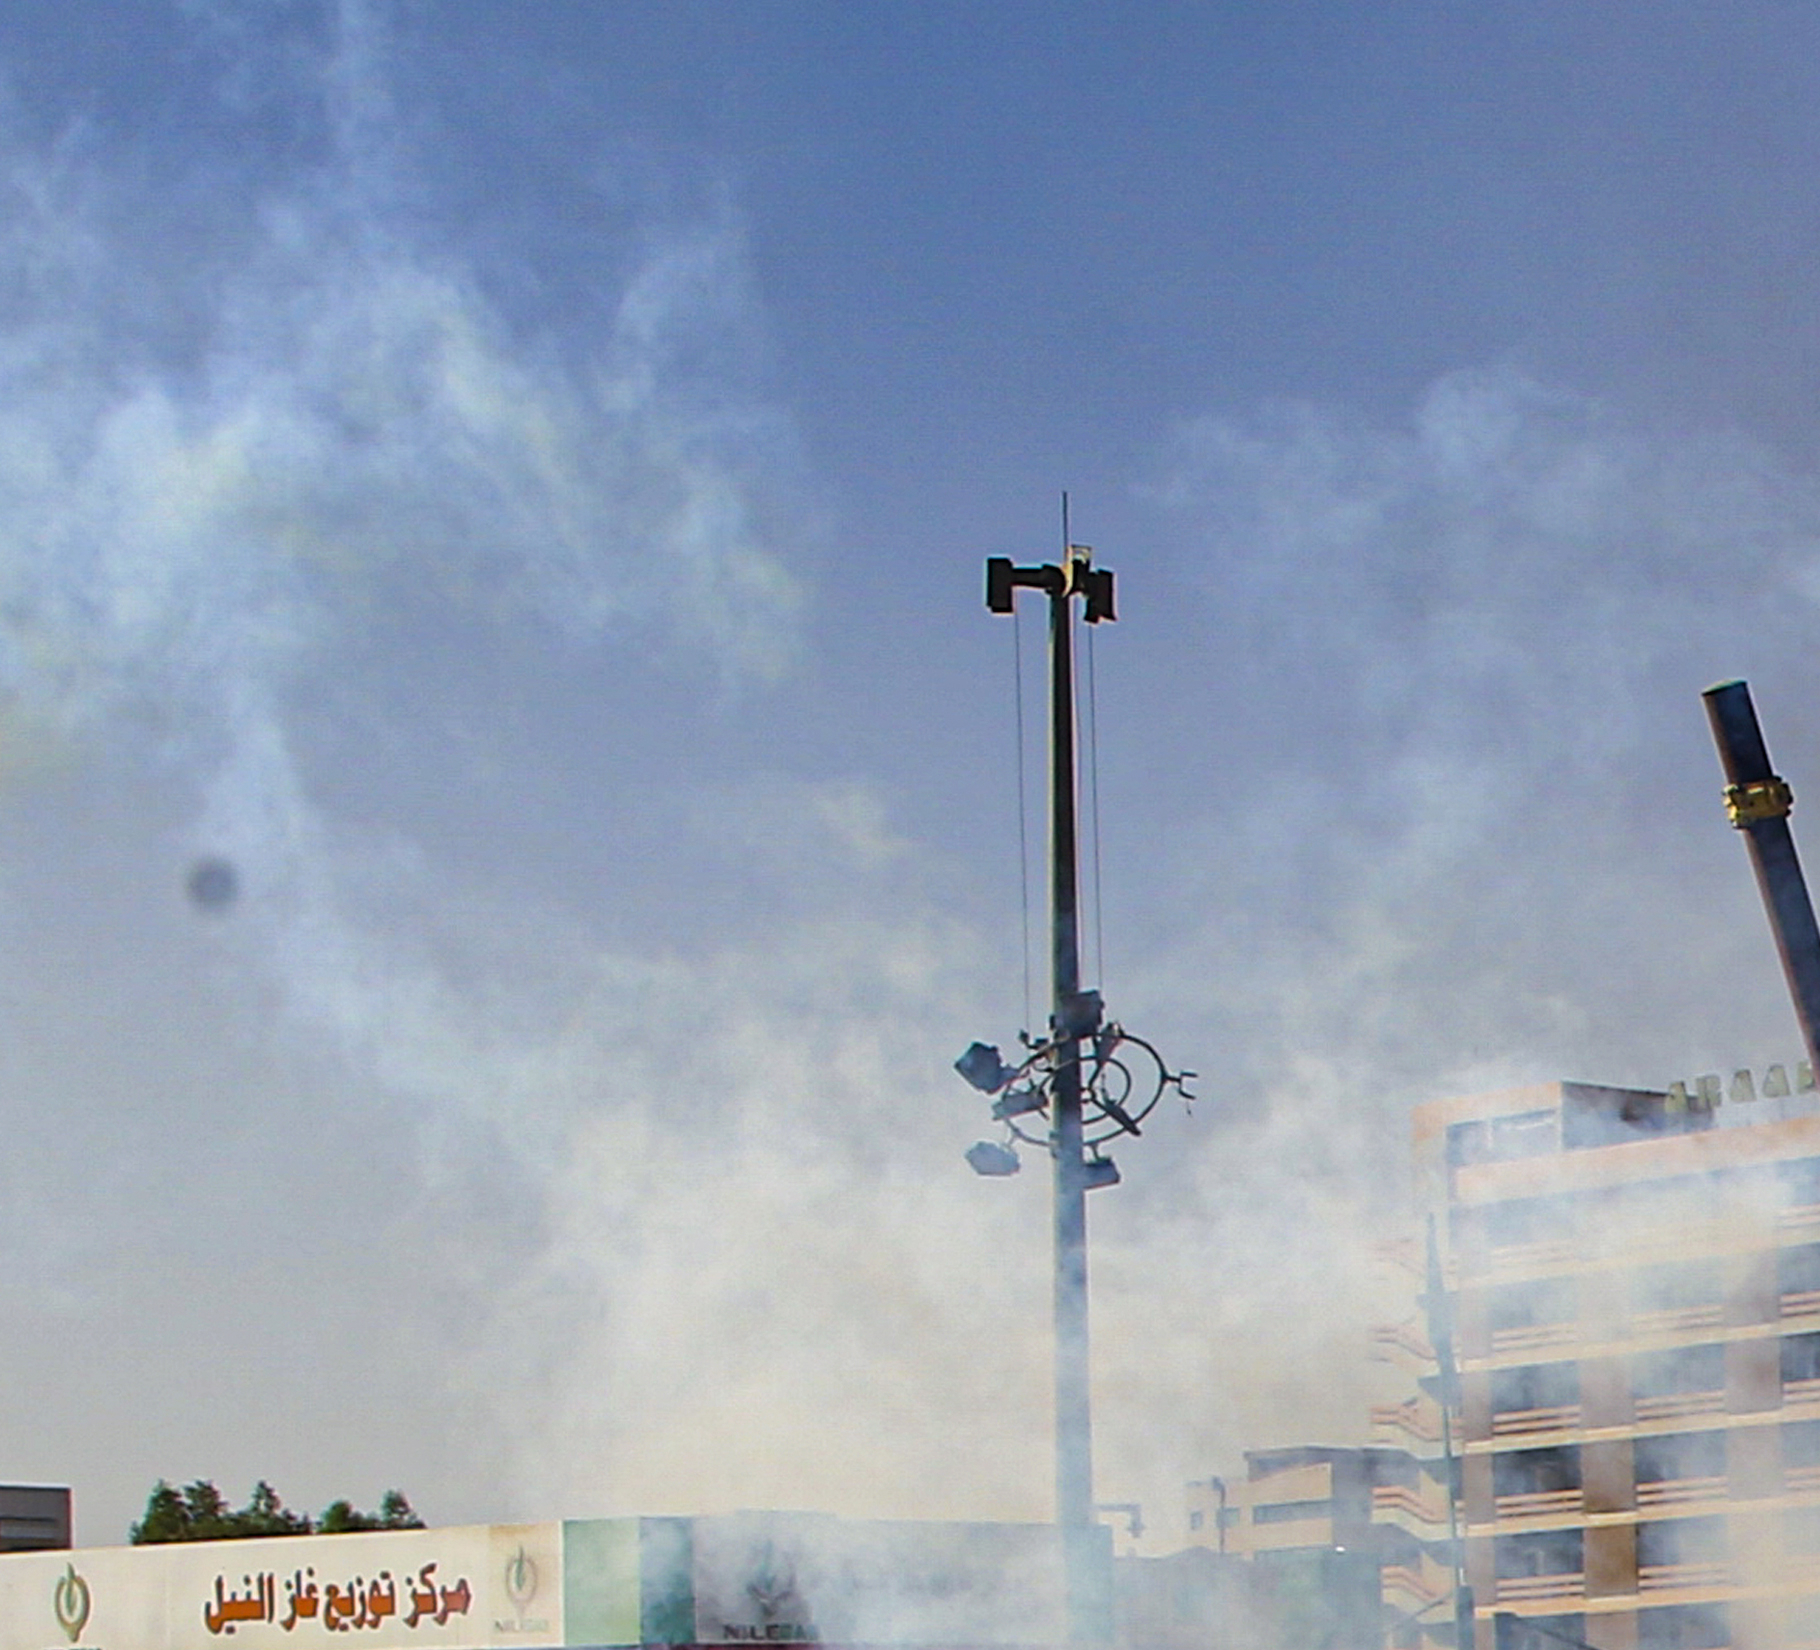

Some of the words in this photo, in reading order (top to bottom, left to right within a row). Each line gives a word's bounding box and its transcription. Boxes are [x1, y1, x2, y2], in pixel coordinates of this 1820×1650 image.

[204, 1571, 275, 1635] النيل
[280, 1566, 319, 1632] غاز
[323, 1570, 396, 1632] توزيع
[403, 1562, 471, 1628] مركز
